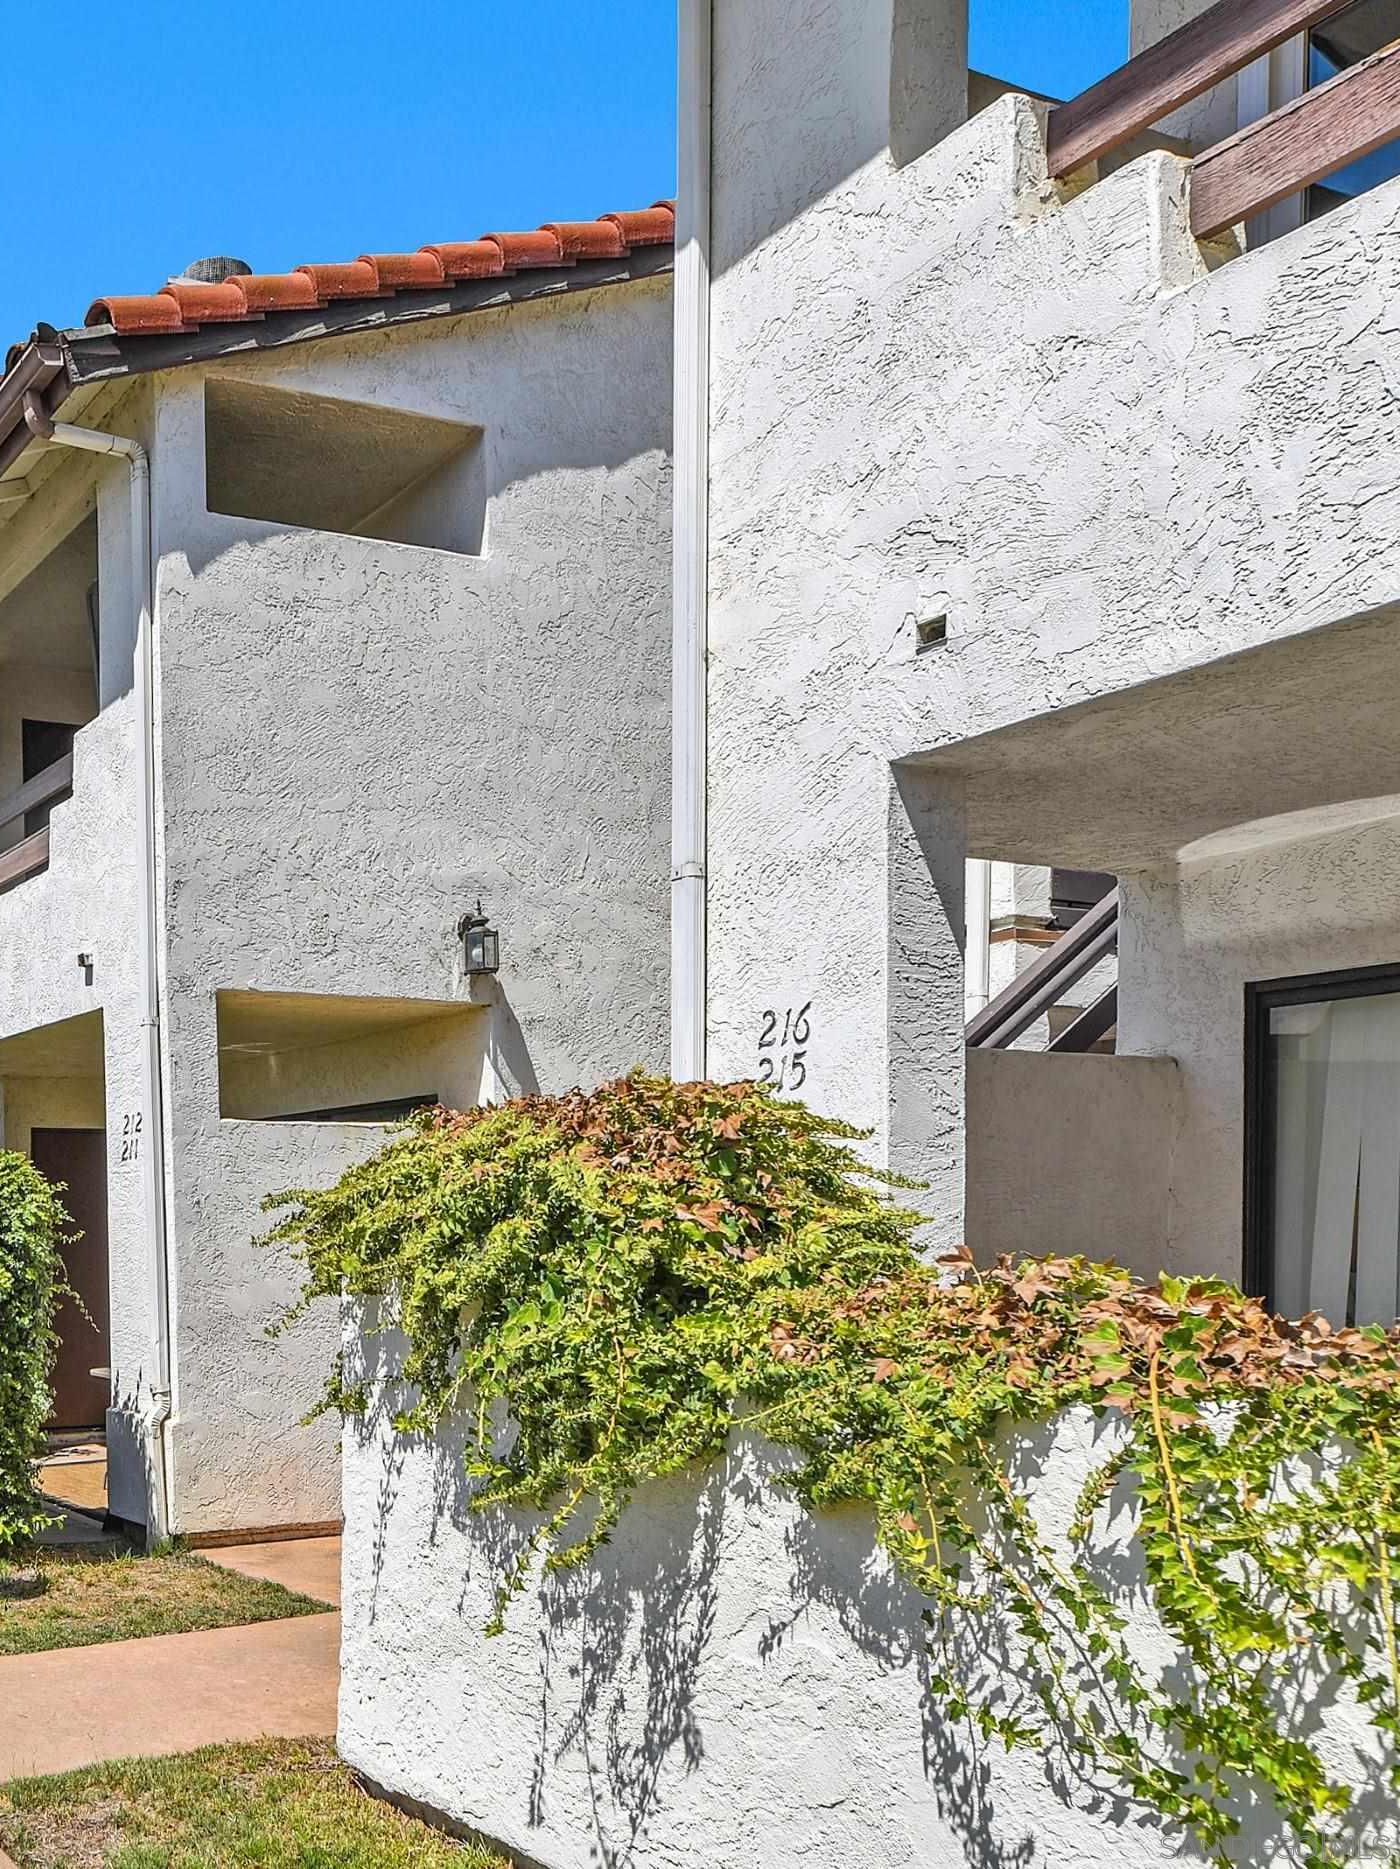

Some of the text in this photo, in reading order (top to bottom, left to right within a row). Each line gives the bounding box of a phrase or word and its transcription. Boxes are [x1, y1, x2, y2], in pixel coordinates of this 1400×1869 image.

[758, 1001, 813, 1050] 216
[758, 1050, 808, 1093] 215
[123, 1112, 143, 1136] 212
[120, 1138, 139, 1162] 211
